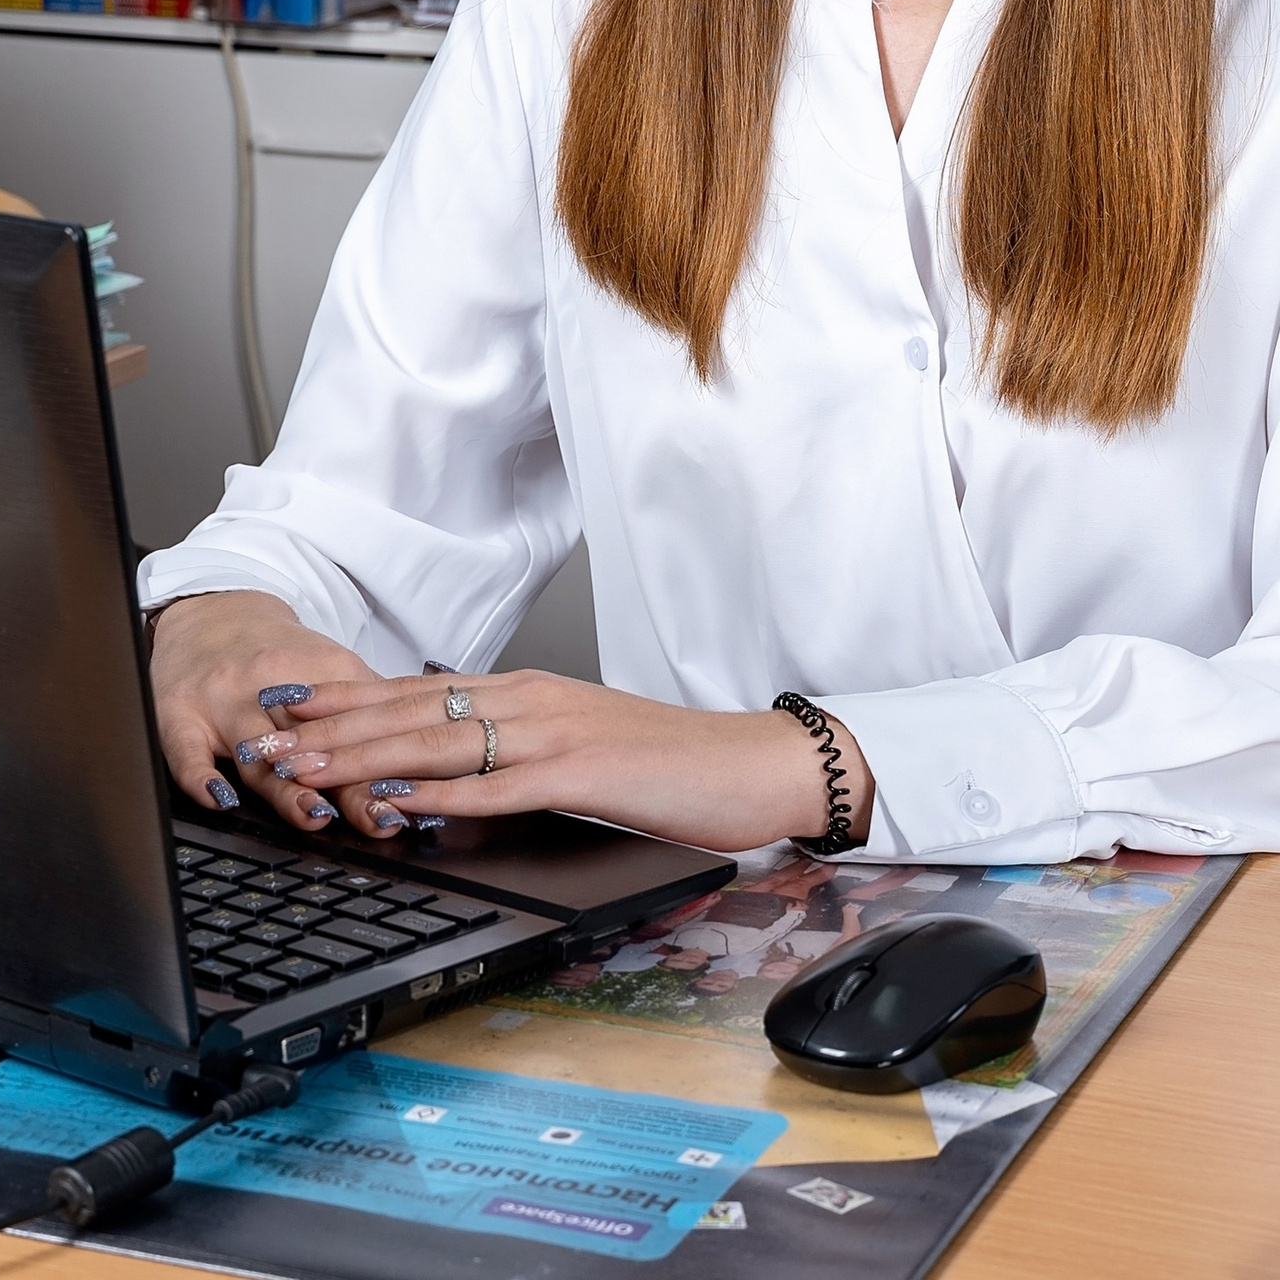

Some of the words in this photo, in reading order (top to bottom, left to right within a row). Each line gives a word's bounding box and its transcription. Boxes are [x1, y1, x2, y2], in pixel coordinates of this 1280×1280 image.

[453, 1137, 551, 1161] клапаном
[425, 1158, 680, 1212] Настольное
[556, 1154, 682, 1184] прозрачным
[498, 1201, 635, 1237] OfficeSpace
